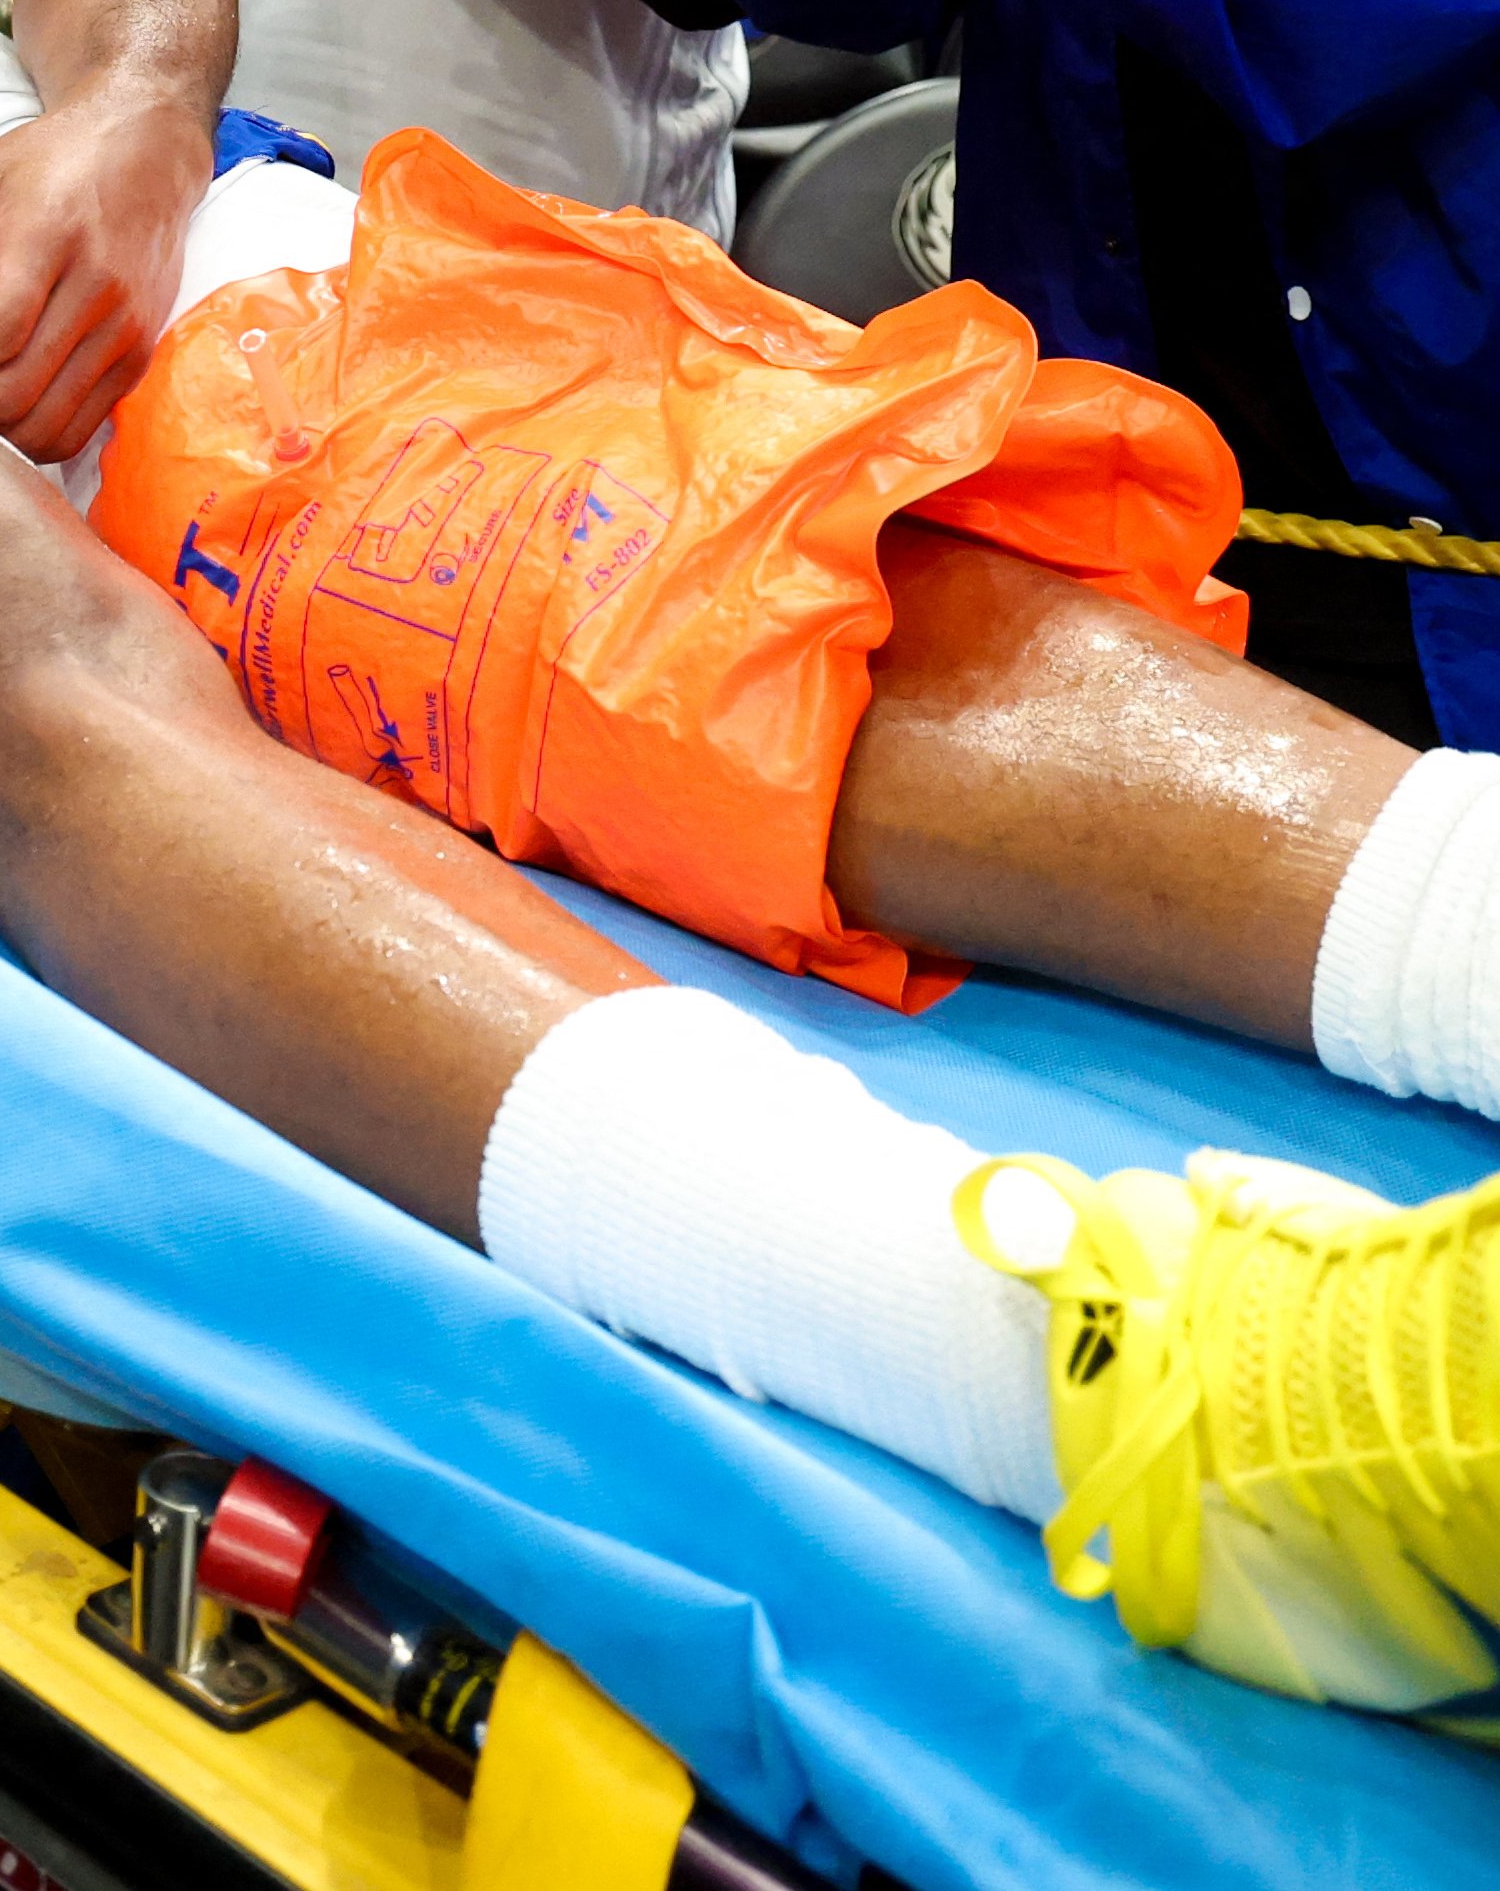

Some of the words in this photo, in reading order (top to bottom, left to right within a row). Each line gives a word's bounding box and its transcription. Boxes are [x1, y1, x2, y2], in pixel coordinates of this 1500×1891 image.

[553, 488, 581, 528] Size
[585, 528, 652, 593] FS-802
[425, 691, 438, 730] VALVE
[427, 733, 441, 774] CLOSE
